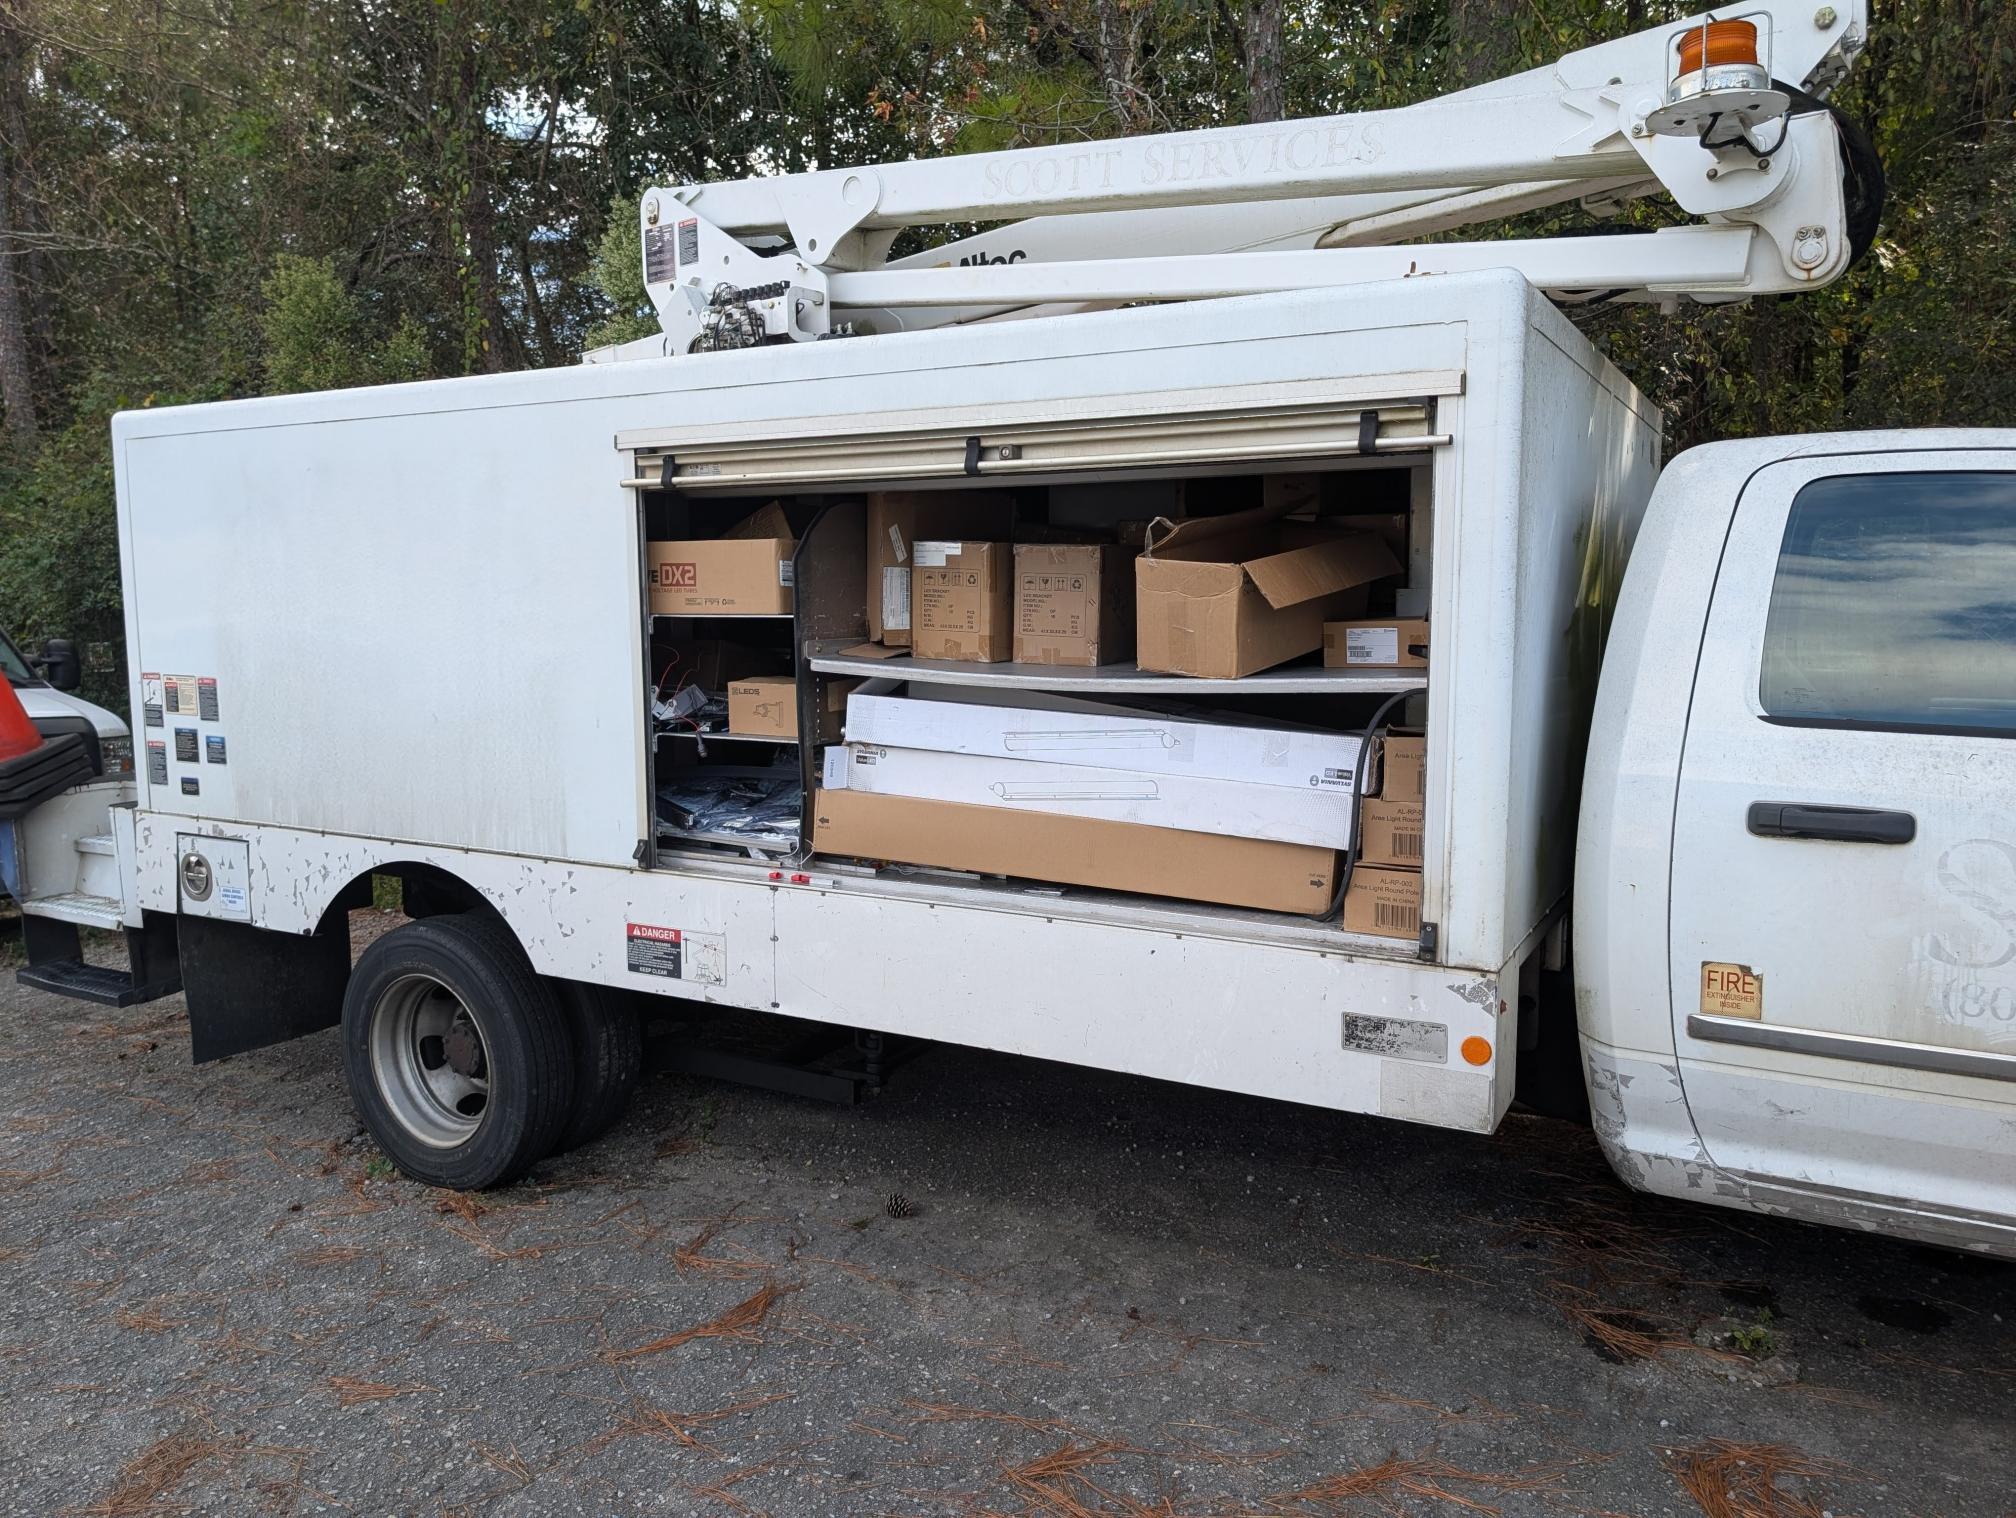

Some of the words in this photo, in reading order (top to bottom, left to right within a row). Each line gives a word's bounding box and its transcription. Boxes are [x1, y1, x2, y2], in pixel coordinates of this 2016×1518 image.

[983, 151, 1121, 199] SCOTT
[1141, 121, 1386, 185] SERVICES
[661, 565, 695, 585] DX2
[1387, 815, 1401, 823] Light
[1380, 878, 1413, 888] AL-RP-002
[1369, 884, 1383, 893] Light
[1385, 886, 1405, 895] Round
[641, 927, 675, 940] DANGER
[652, 968, 668, 976] CLEAR
[1707, 970, 1755, 995] FIRE
[1706, 991, 1755, 1003] EXTINGUISHER
[1720, 1000, 1741, 1010] INSIDE
